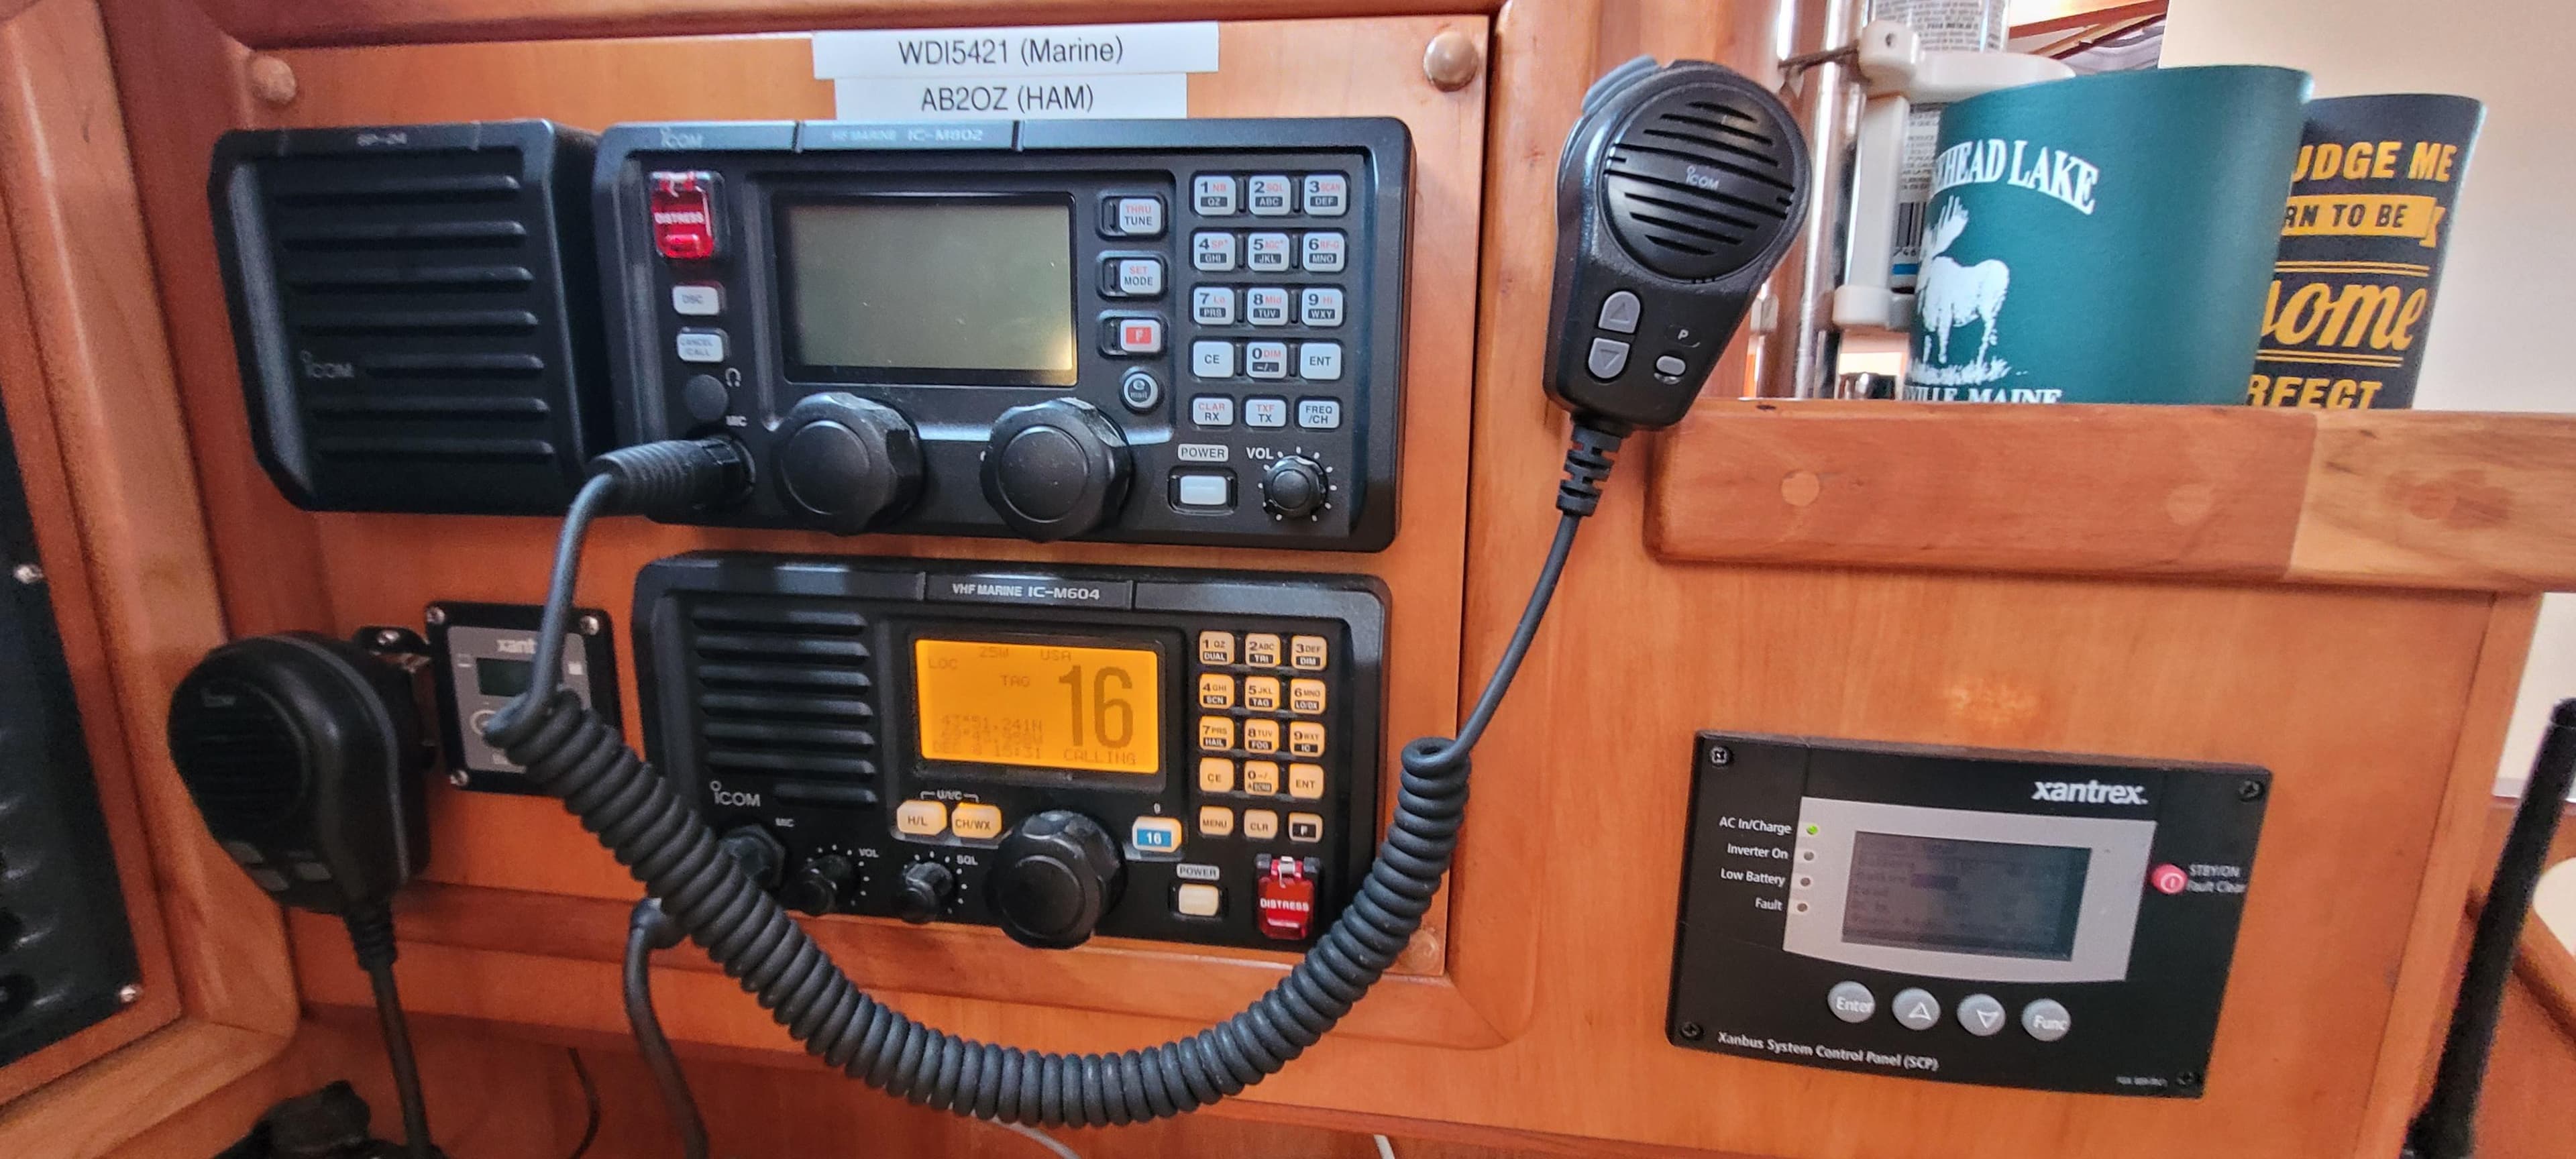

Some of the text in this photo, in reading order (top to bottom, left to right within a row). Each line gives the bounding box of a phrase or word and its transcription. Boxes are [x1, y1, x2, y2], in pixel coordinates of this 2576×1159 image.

[898, 36, 1124, 67] WDI5421 (Marine)
[1018, 85, 1093, 112] (HAM)
[2408, 142, 2457, 182] ME
[2007, 140, 2098, 215] LAKE
[1200, 181, 1209, 193] 1
[1254, 181, 1265, 193] 2
[1309, 181, 1320, 193] 3
[1259, 197, 1279, 206] ABC
[1315, 197, 1334, 205] DEF
[1126, 205, 1152, 214] THRU
[1124, 215, 1152, 226] TUNE
[2332, 205, 2366, 227] TO
[2375, 205, 2408, 227] BE
[1199, 238, 1210, 250] 4
[1253, 238, 1264, 250] 5
[1308, 238, 1320, 250] 6
[1259, 254, 1277, 263] JKL
[1312, 254, 1334, 263] MNO
[1129, 266, 1148, 275] SET
[1124, 277, 1153, 287] MODE
[1199, 292, 1210, 305] 7
[1253, 293, 1264, 305] 8
[1308, 294, 1319, 306] 9
[1258, 309, 1277, 318] TUV
[1311, 310, 1333, 319] WXY
[1678, 329, 1688, 339] P
[1204, 354, 1220, 364] CE
[1264, 349, 1281, 359] DIM
[1309, 356, 1332, 366] ENT
[1198, 402, 1226, 410] CLAR
[1256, 404, 1275, 412] TXF
[1305, 404, 1333, 415] FREQ
[1205, 412, 1220, 421] RX
[1258, 413, 1272, 423] TX
[1307, 414, 1328, 424] /CH
[1181, 447, 1225, 459] POWER
[1246, 447, 1274, 460] VOL
[953, 583, 1100, 600] VHF MARINE IC-M604
[1202, 639, 1210, 649] 1
[1248, 641, 1275, 651] 2 ABC
[1295, 643, 1322, 653] 3 DEF
[1040, 649, 1072, 661] USA
[1203, 652, 1226, 661] DUAL
[1254, 654, 1269, 663] TRI
[928, 657, 958, 670] LOC
[1299, 657, 1317, 666] DIM
[1000, 674, 1031, 687] TAG
[1203, 682, 1212, 692] 4
[1248, 685, 1273, 695] 5 JKL
[1294, 687, 1302, 697] 6
[1206, 696, 1224, 704] SCN
[1252, 698, 1270, 707] TAG
[1058, 664, 1134, 749] 16
[1203, 725, 1211, 734] 7
[1248, 728, 1256, 738] 8
[1294, 730, 1303, 740] 9
[1205, 738, 1224, 747] HAIL
[1251, 740, 1269, 750] FOG
[1063, 750, 1136, 766] CALLING
[1208, 773, 1222, 783] CE
[1296, 780, 1316, 788] ENT
[908, 816, 928, 826] H/L
[955, 818, 991, 830] CH/WX
[1203, 819, 1227, 828] MENU
[1719, 816, 1792, 836] AC In/Charge
[1250, 822, 1269, 831] CLR
[1146, 832, 1162, 844] 16
[859, 848, 879, 859] VOL
[1727, 843, 1788, 859] Inverter On
[957, 854, 978, 865] SQL
[1180, 867, 1218, 877] POWER
[1721, 868, 1785, 887] Low Battery
[1260, 897, 1309, 912] DISTRESS
[1755, 897, 1782, 911] Fault
[1836, 997, 1872, 1013] Enter
[2033, 1015, 2065, 1031] Func
[1718, 1031, 1939, 1071] Xanbus System Control Panel (SCP)
